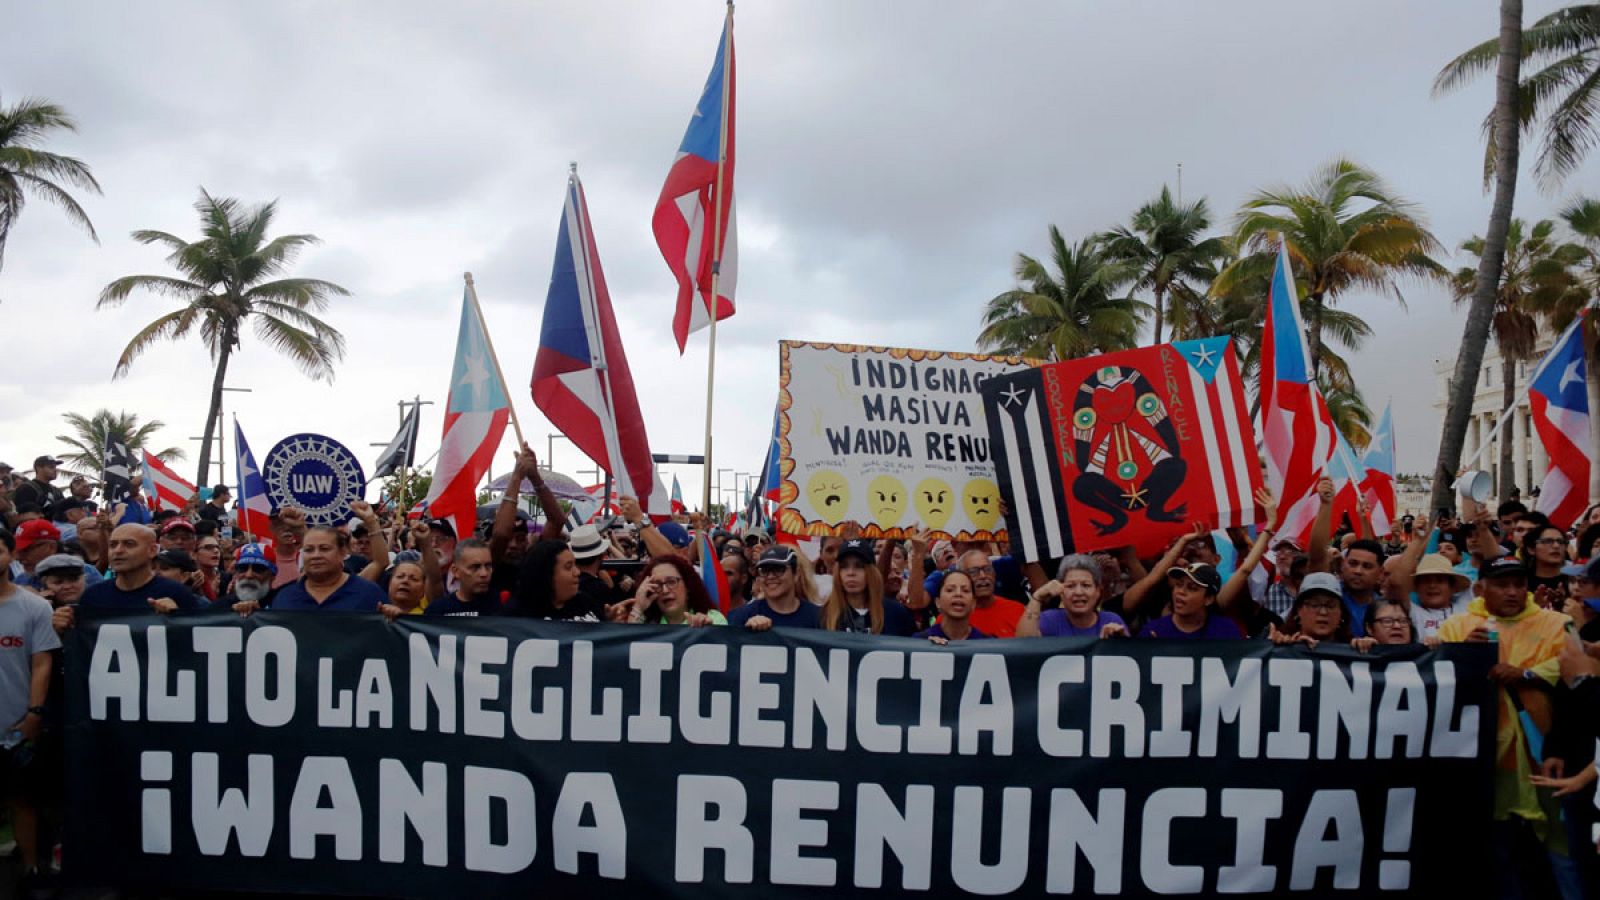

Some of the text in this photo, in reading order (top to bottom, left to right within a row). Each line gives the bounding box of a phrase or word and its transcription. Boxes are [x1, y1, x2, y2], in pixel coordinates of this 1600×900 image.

[851, 355, 1006, 394] INDIGNAC
[1160, 348, 1190, 440] RENACE
[862, 393, 971, 427] MASIVA
[826, 425, 994, 463] WANDA RENU
[292, 474, 333, 494] UAW
[89, 624, 1480, 759] ALTO LA NEGLIGENCIA CRIMINAL
[141, 751, 1415, 894] ¡WANDA RENUNCIA!
